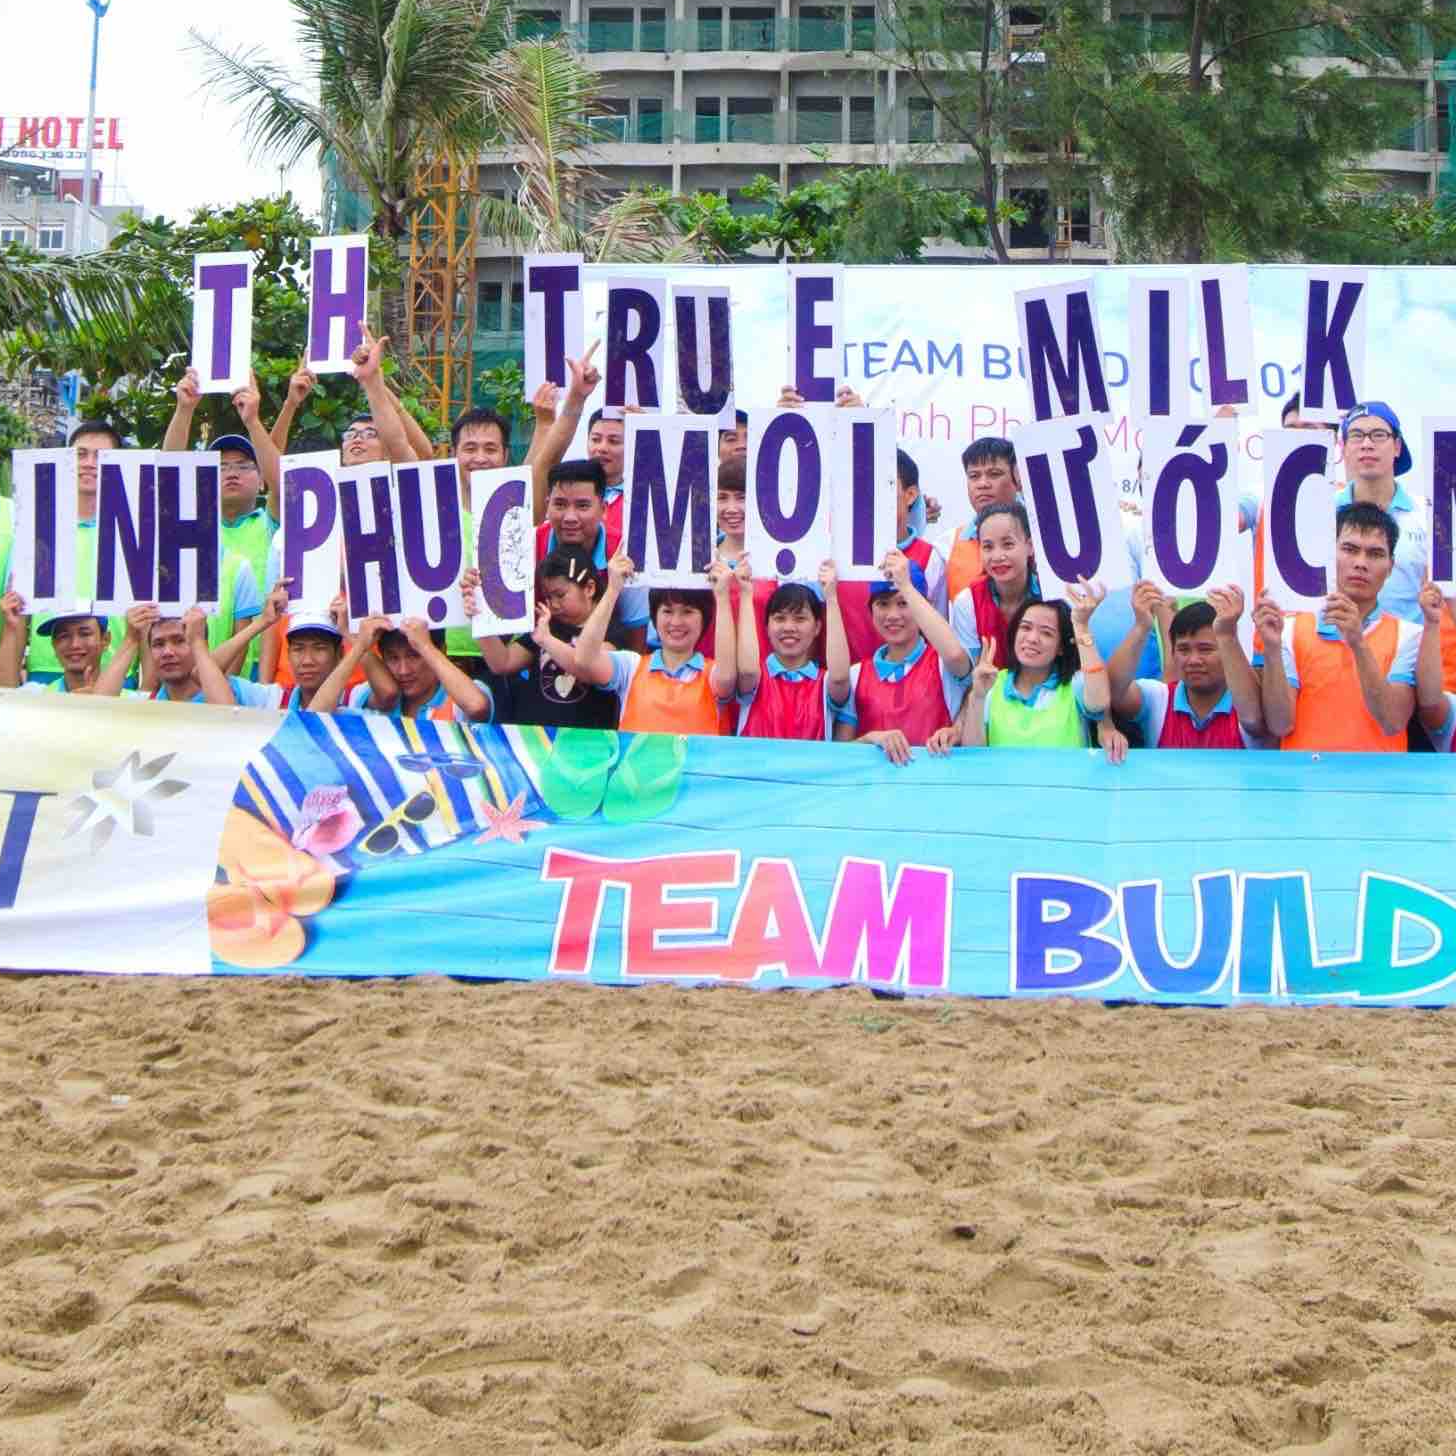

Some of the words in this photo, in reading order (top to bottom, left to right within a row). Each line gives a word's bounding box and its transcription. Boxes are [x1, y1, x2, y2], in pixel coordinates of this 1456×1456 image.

[18, 116, 124, 150] HOTEL
[528, 264, 836, 416] TRUE
[1023, 278, 1365, 421] MILK
[843, 339, 964, 379] TEAM
[284, 459, 528, 624] PHỤC
[627, 410, 875, 577] MỌI
[1024, 424, 1329, 599] ƯỚC
[540, 846, 954, 992] TEAM
